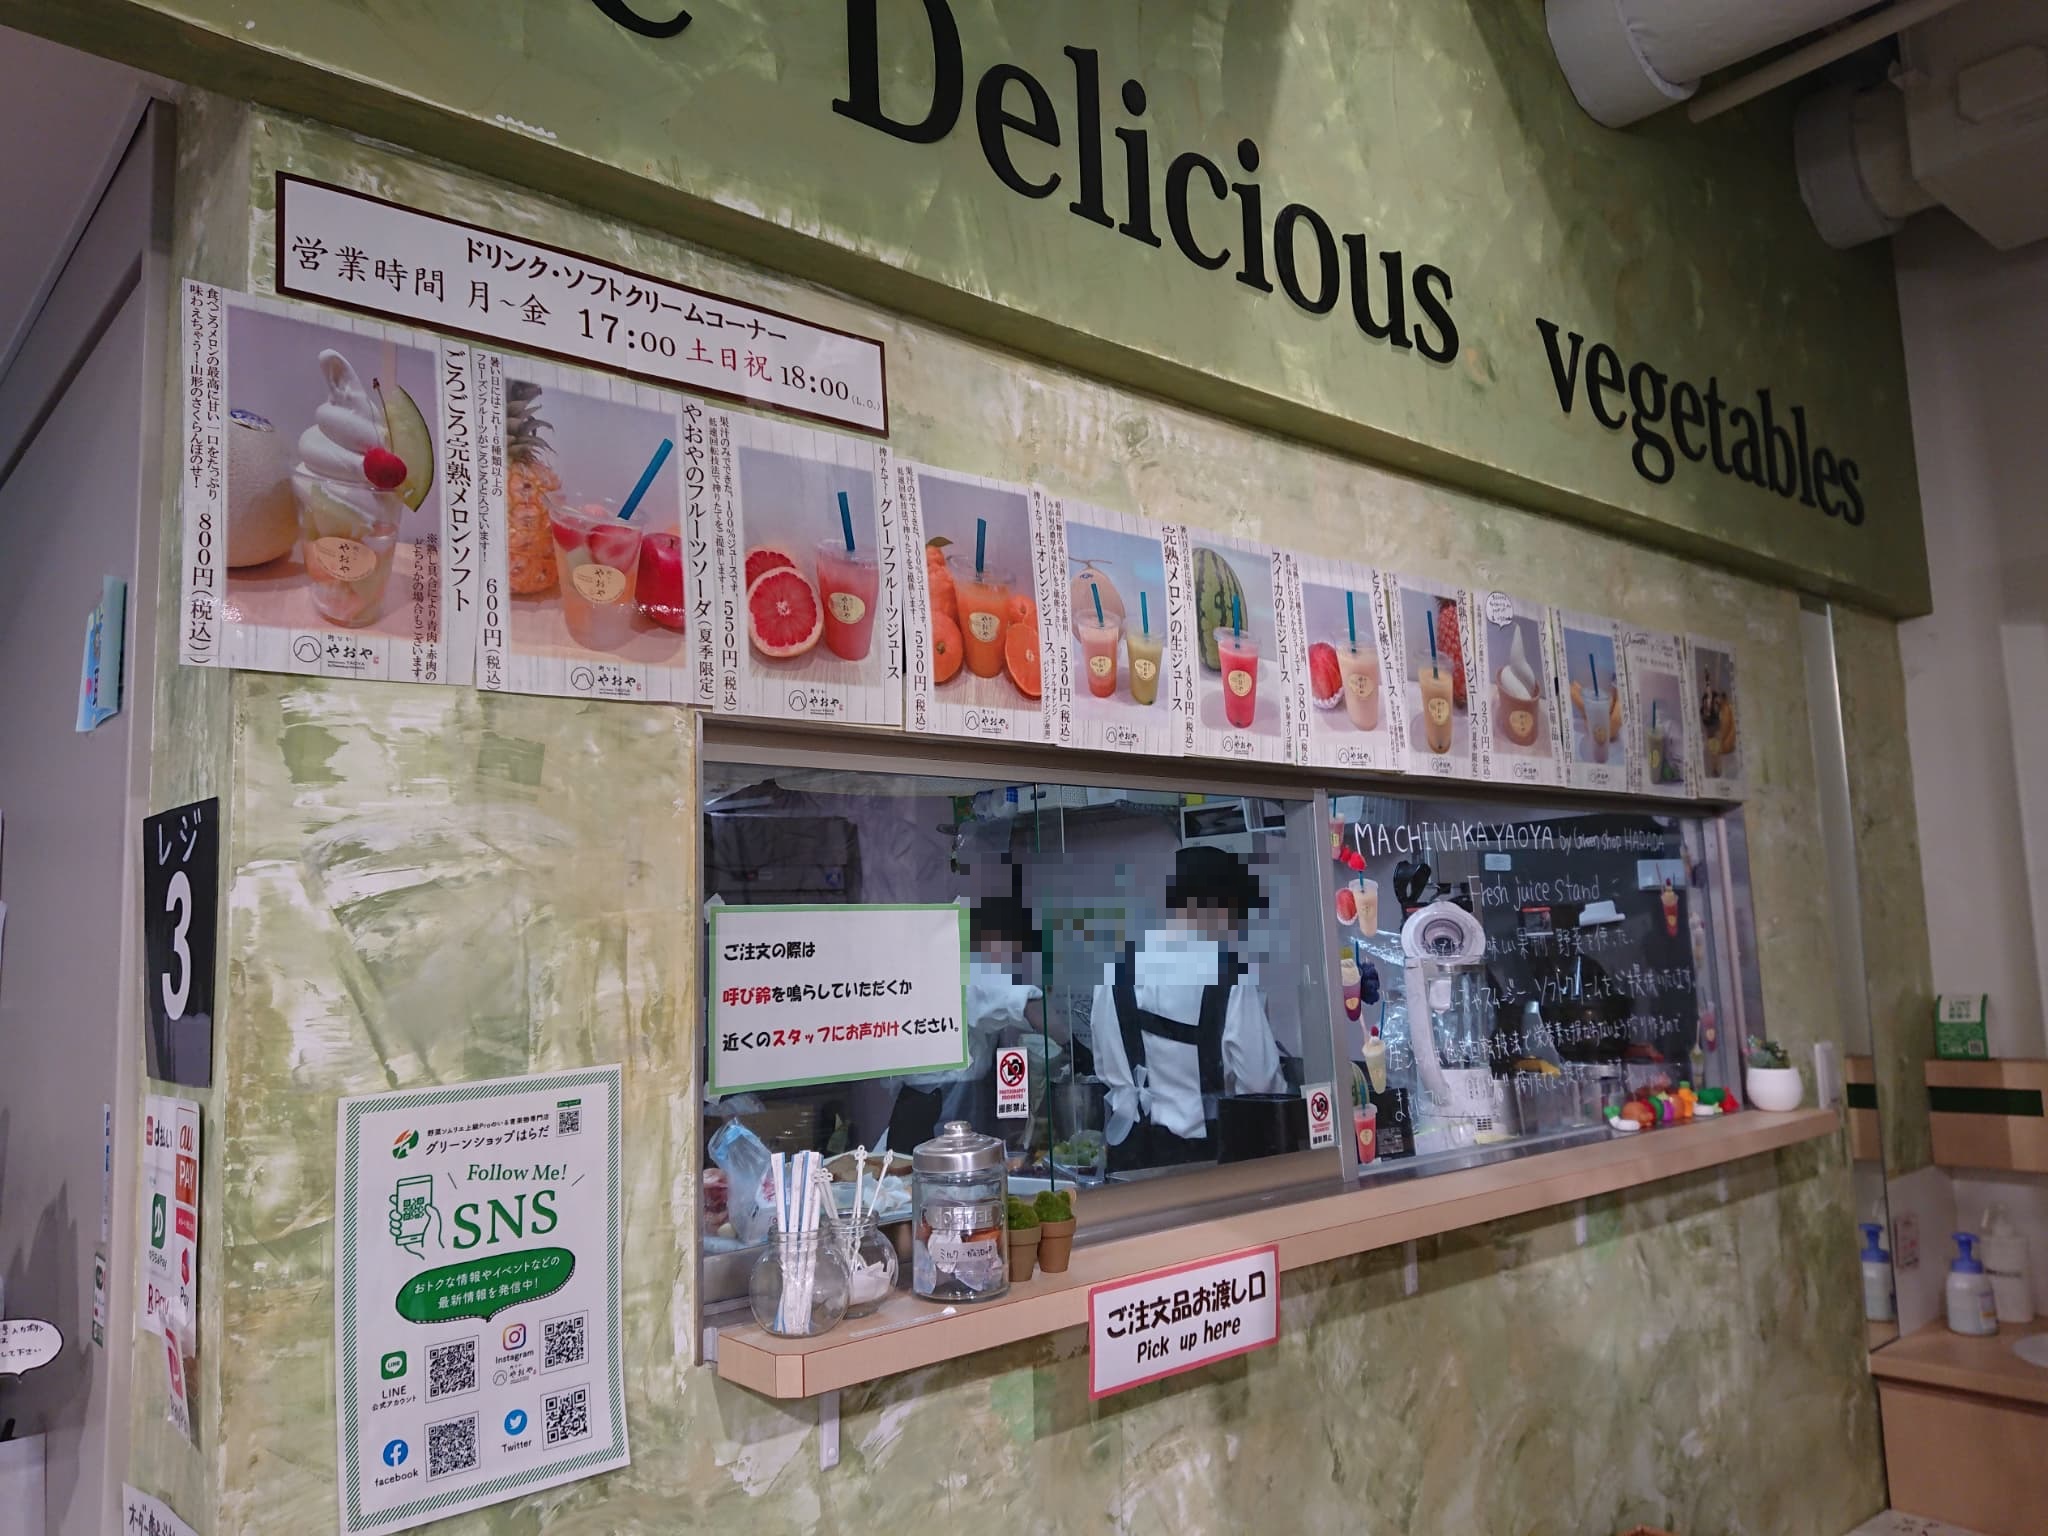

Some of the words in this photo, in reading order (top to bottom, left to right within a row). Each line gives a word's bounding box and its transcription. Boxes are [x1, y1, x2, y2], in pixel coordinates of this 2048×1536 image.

[832, 0, 1459, 363] Delicious
[1536, 317, 1865, 527] vegetables
[466, 237, 787, 341] ドリンク・ソフトクリームコーナー
[291, 235, 444, 303] 営業時間
[577, 308, 676, 357] 17:00
[686, 337, 772, 383] 土日祝
[780, 365, 849, 400] 18:00
[445, 349, 472, 613] ごろごろ完熟メロンソフト
[338, 543, 351, 574] やおや
[880, 498, 900, 680] グレープフルーツジュース
[483, 578, 502, 691] 600円(税込)
[1161, 525, 1184, 711] 完熟メロンの生ジュース
[326, 643, 373, 660] やおや
[722, 600, 738, 712] 550円(税込)
[597, 674, 637, 688] やおや
[809, 696, 840, 709] やおや
[157, 807, 202, 866] レジ
[1467, 873, 1511, 907] Fresh
[1510, 876, 1550, 911] juice
[161, 870, 193, 1021] 3
[723, 941, 816, 962] ご注文の際は
[722, 980, 913, 1007] 呼び鈴を鳴らしていただくか
[722, 1017, 960, 1052] 近くのスタッフにお声がけください。
[179, 1124, 194, 1153] au
[425, 1124, 550, 1156] グリーンショップはらだ
[179, 1160, 195, 1189] PAY
[466, 1163, 529, 1181] Follow
[532, 1163, 567, 1181] Me!
[453, 1189, 558, 1250] SNS
[414, 1255, 561, 1295] おトクな情報やイベントなどの
[436, 1277, 539, 1310] 最新情報を発信中!
[1106, 1269, 1266, 1339] ご注文品お渡し口
[495, 1349, 535, 1364] Instagram
[1136, 1335, 1169, 1364] Pick
[1179, 1332, 1197, 1352] up
[1203, 1316, 1241, 1345] here
[371, 1395, 417, 1412] 公式アカウント
[381, 1385, 407, 1400] LINE
[502, 1438, 533, 1453] Twitter
[375, 1468, 419, 1488] facebook
